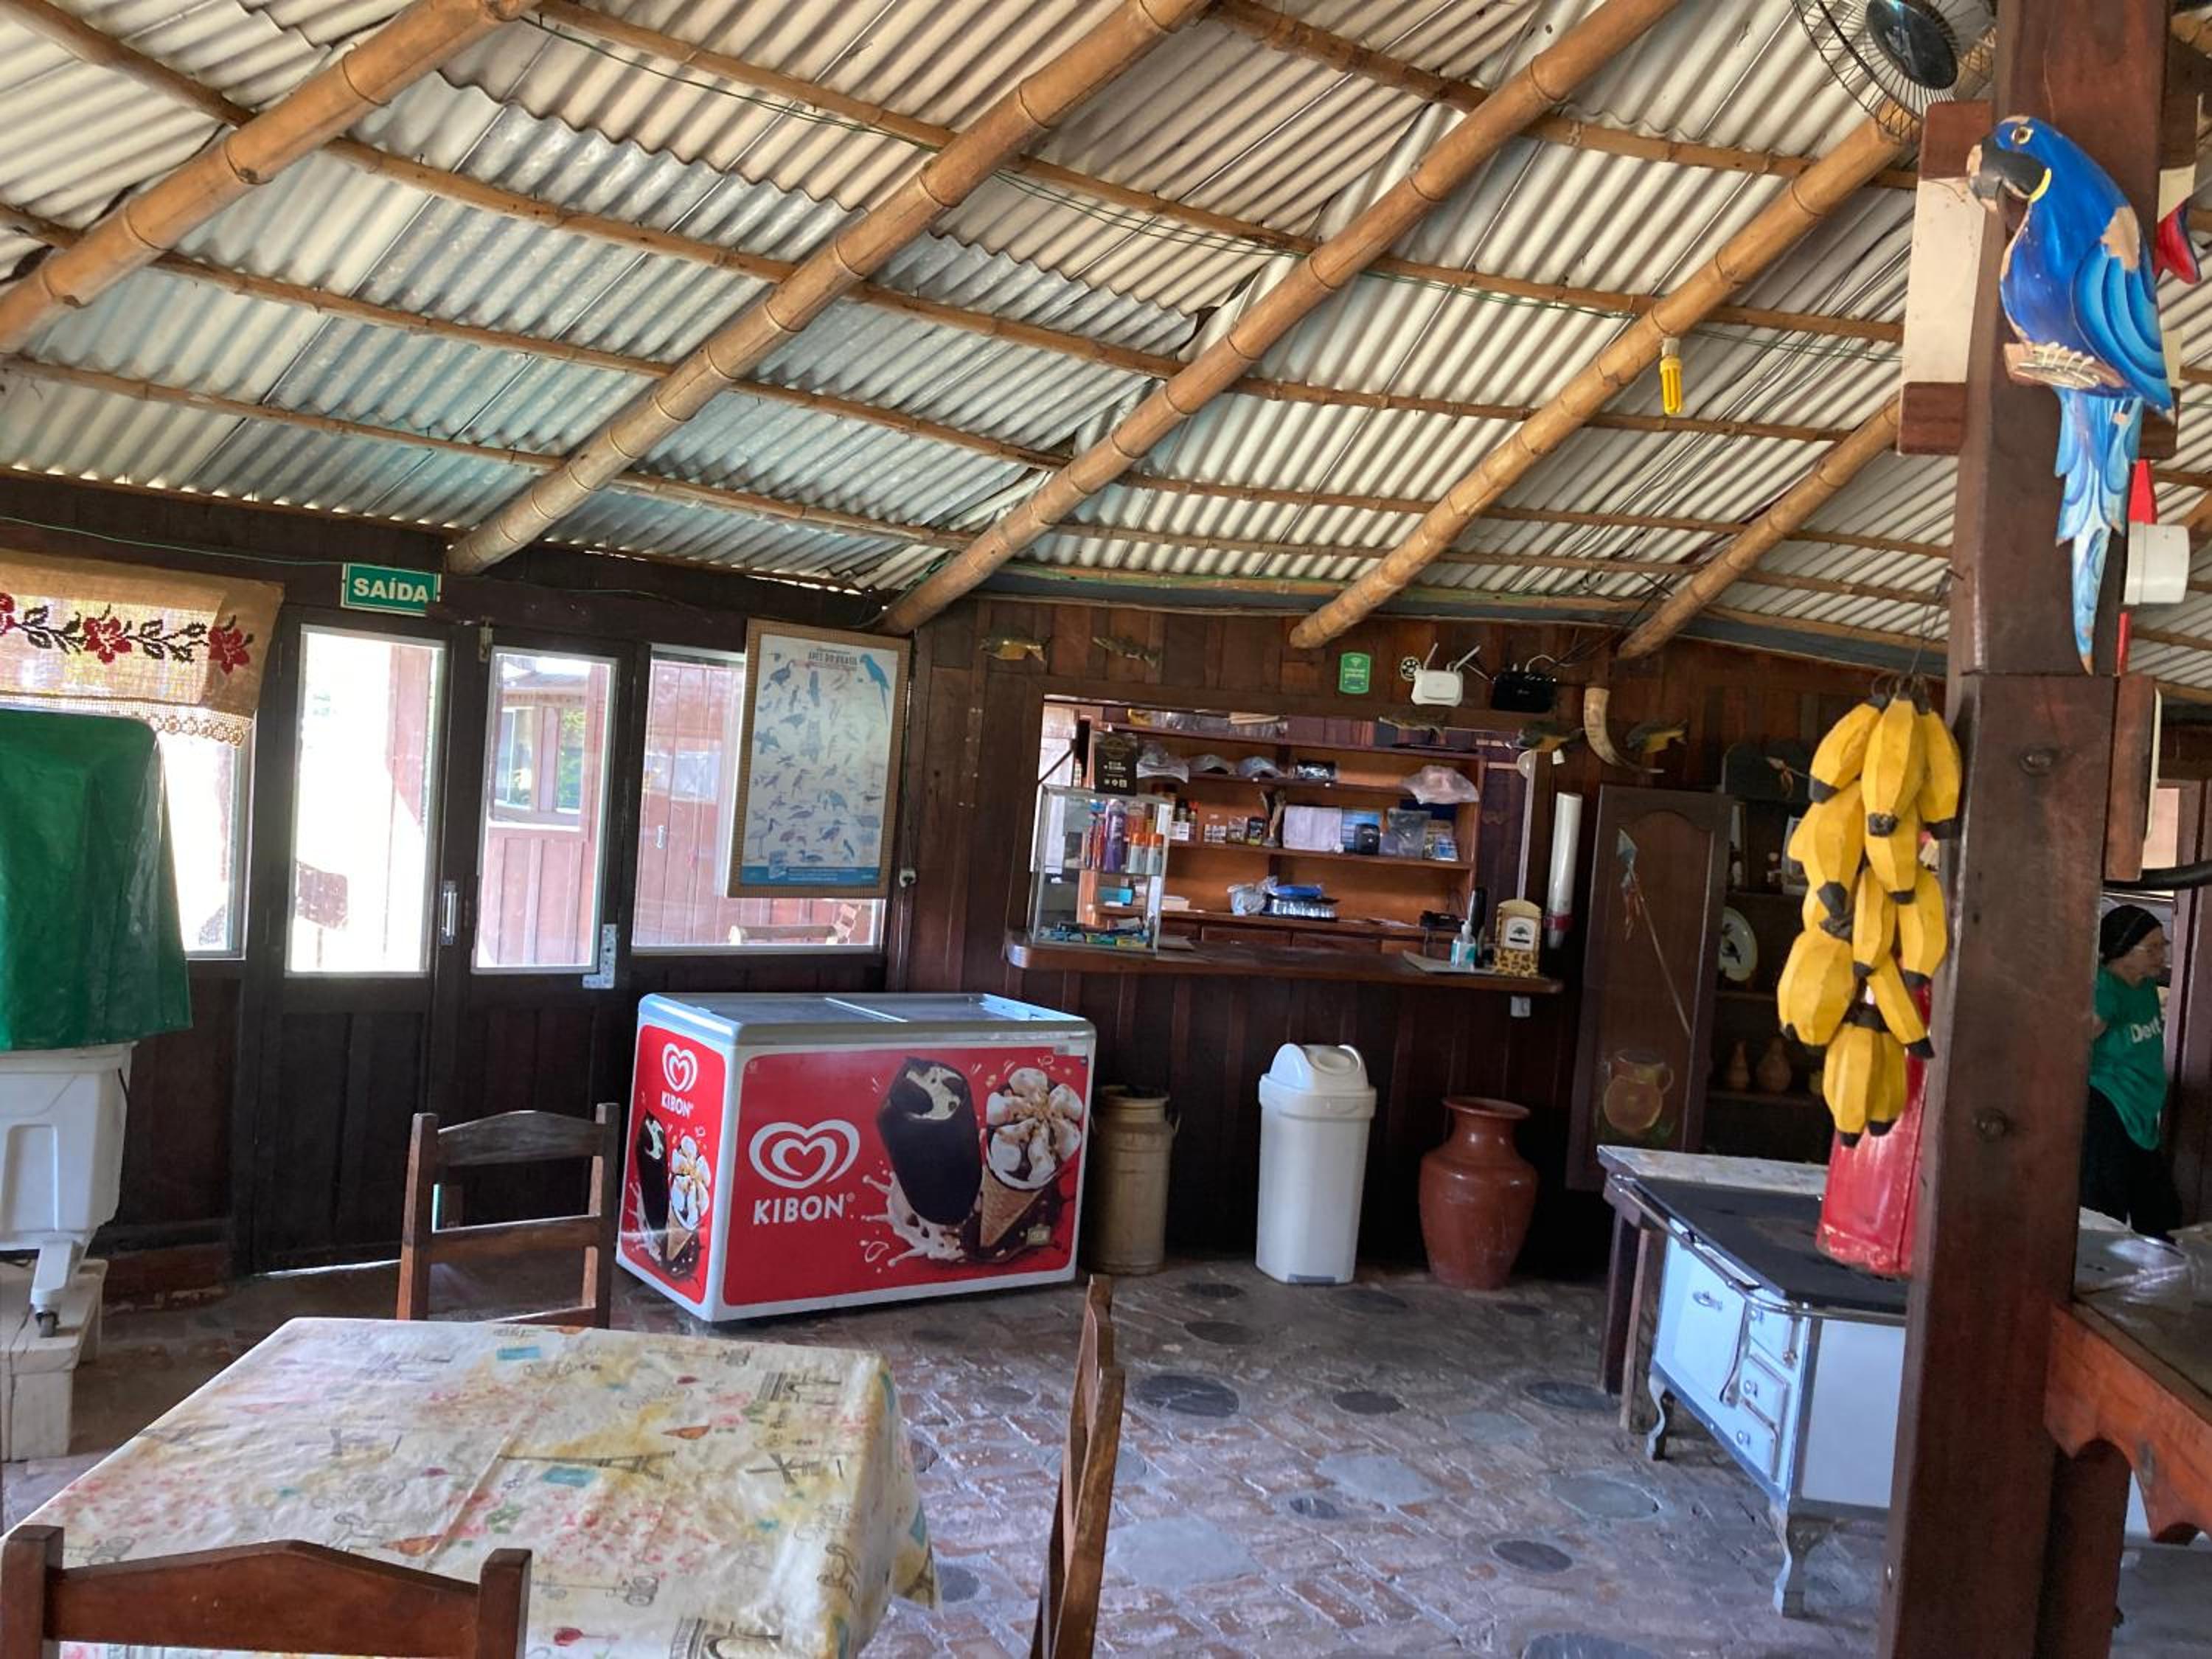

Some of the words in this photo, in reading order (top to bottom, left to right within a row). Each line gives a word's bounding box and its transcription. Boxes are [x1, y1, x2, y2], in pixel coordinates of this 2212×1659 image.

[353, 577, 428, 603] SAÍDA
[661, 1091, 691, 1120] KIBON
[753, 1192, 845, 1225] KIBON
